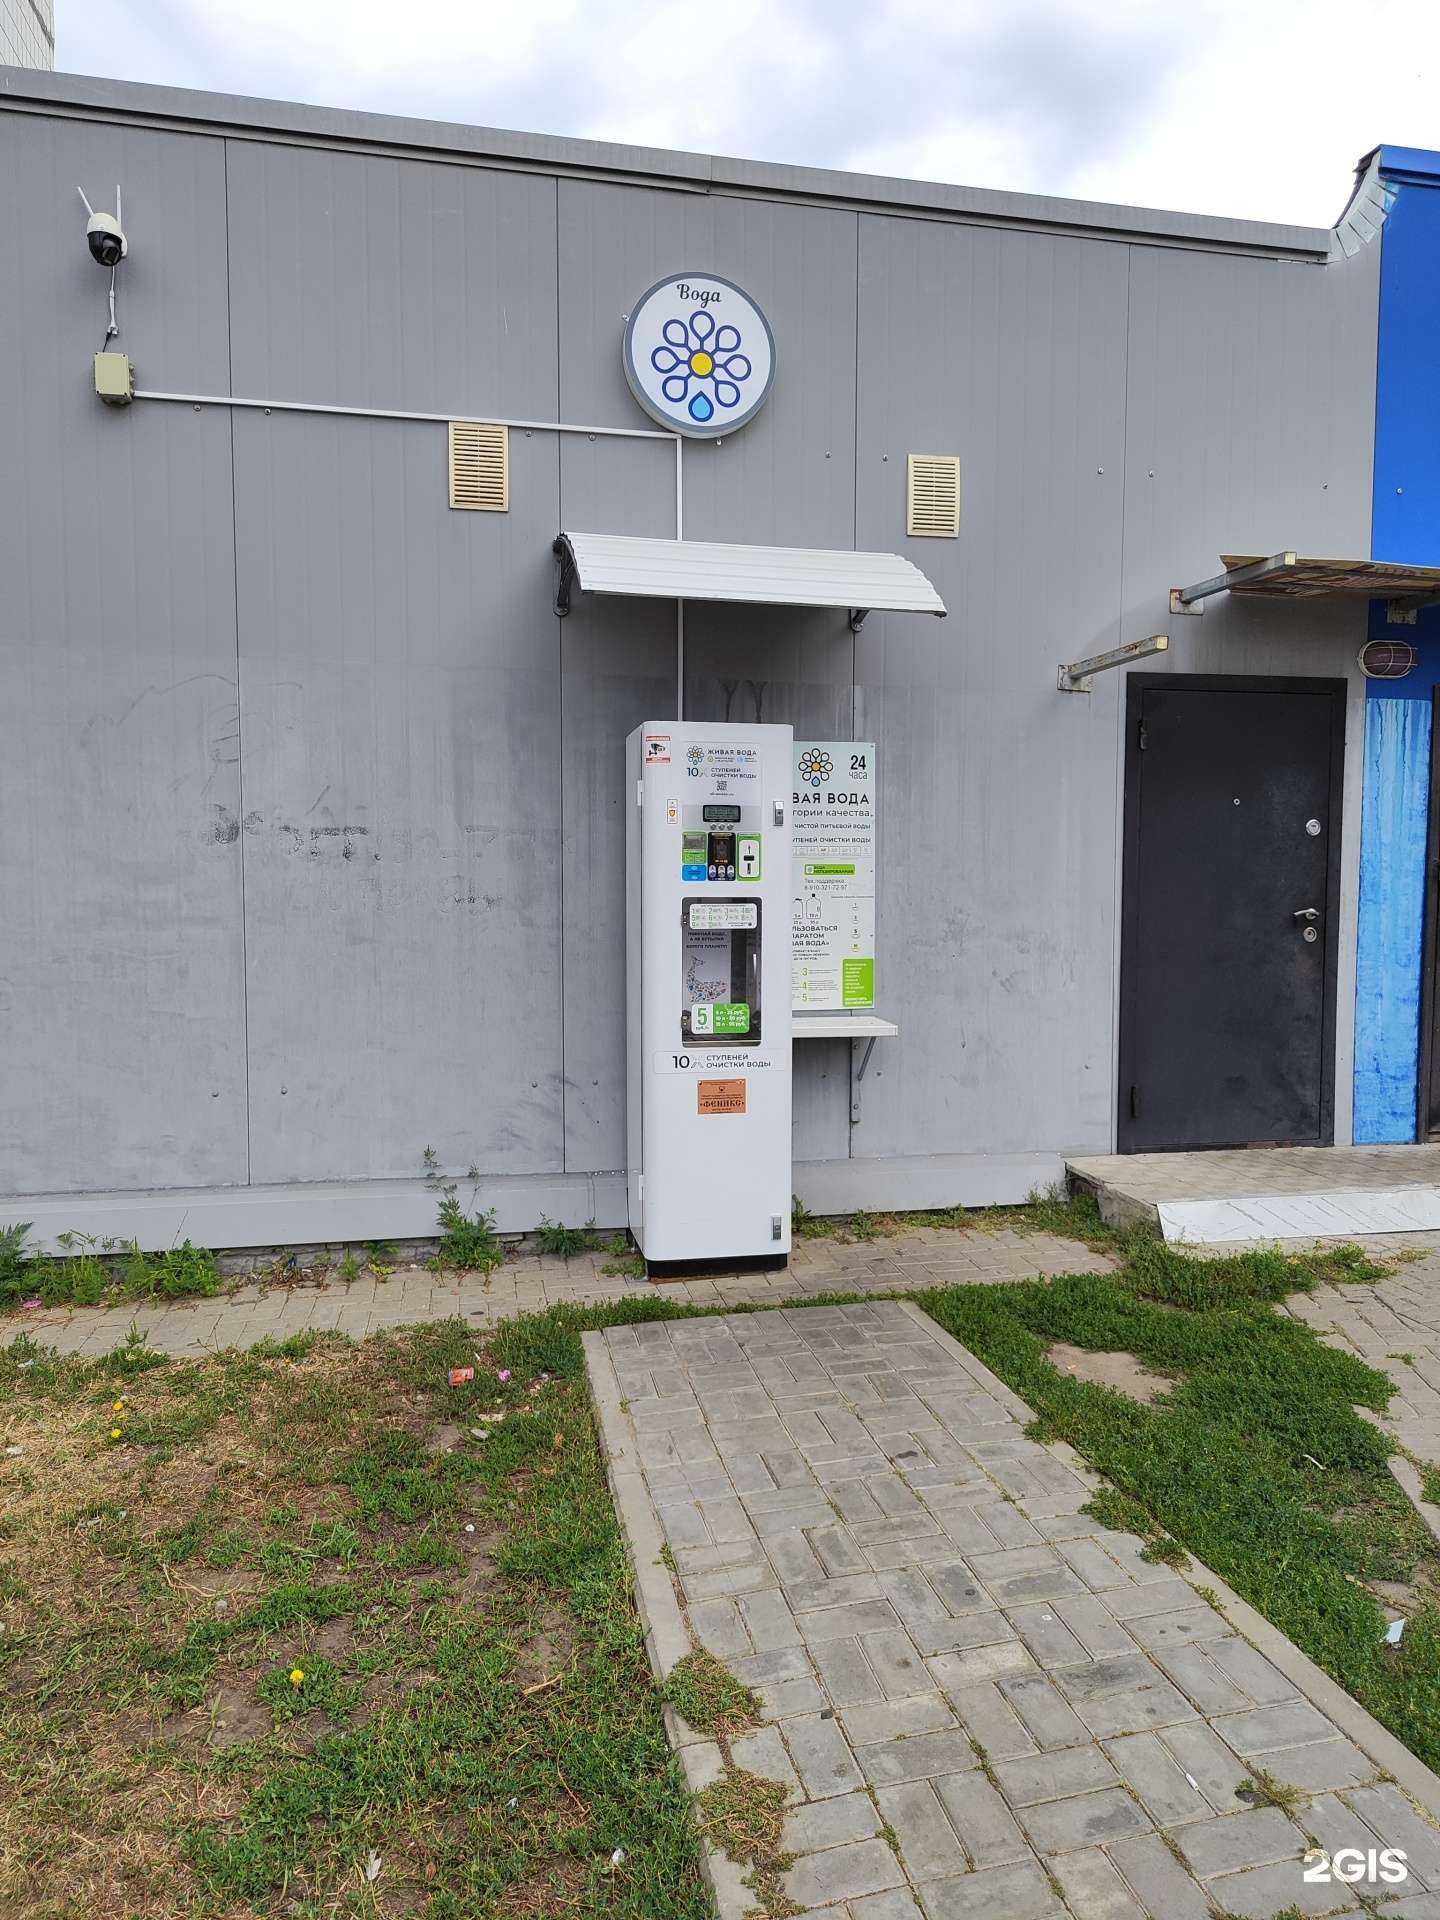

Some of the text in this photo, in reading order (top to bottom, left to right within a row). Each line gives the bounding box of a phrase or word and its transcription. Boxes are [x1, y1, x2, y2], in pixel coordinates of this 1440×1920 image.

[676, 283, 722, 308] Вода
[736, 749, 757, 757] ВОДА
[850, 755, 866, 770] 24
[687, 767, 699, 777] 10
[848, 771, 868, 780] часа
[827, 792, 869, 806] ВОДА
[698, 1007, 708, 1025] 5
[672, 1055, 690, 1068] 10
